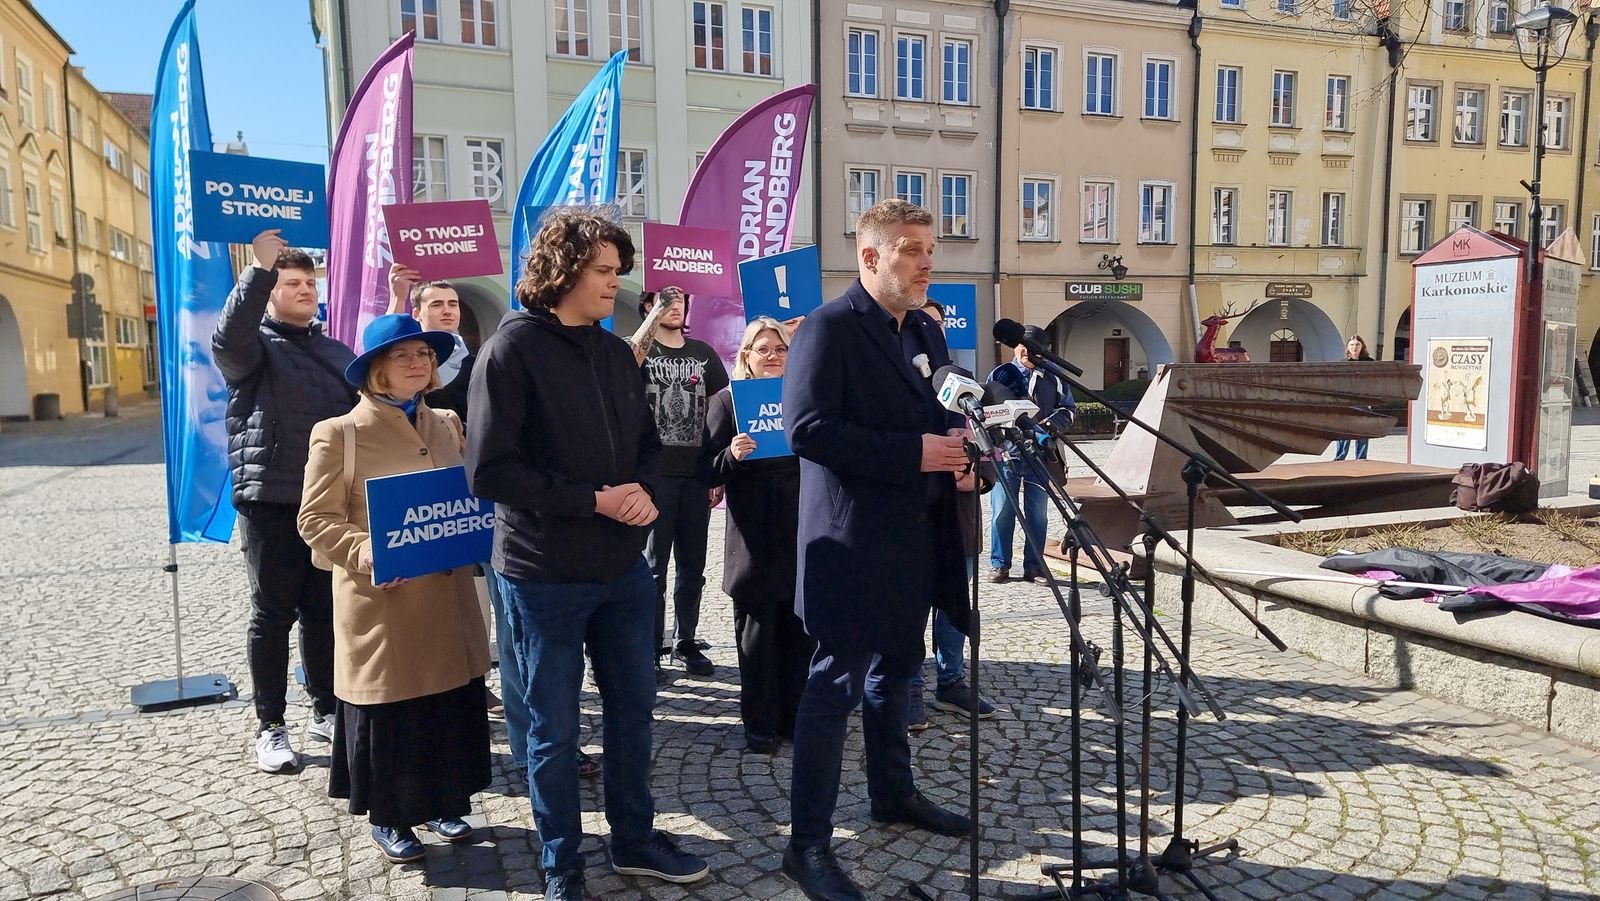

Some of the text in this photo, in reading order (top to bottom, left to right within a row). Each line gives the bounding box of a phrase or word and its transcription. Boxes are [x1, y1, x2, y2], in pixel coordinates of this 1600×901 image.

[205, 180, 314, 204] PO TWOJEJ
[763, 113, 796, 257] ANDBERG
[364, 132, 379, 269] ADRIAN
[221, 200, 302, 220] STRONIE
[738, 160, 766, 262] DRIAN
[399, 224, 484, 242] PO TWOJEJ
[414, 240, 478, 257] STRONIE
[1452, 238, 1471, 251] MK
[663, 246, 713, 261] ADRIAN
[652, 258, 724, 275] ZANDBERG
[1434, 270, 1482, 284] MUZEUM
[1069, 284, 1140, 294] CLUB SUSHI
[1421, 282, 1508, 297] Karkonoskie
[1451, 354, 1485, 365] CZASY
[402, 497, 480, 526] ADRIAN
[386, 512, 496, 549] ZANDBERG
